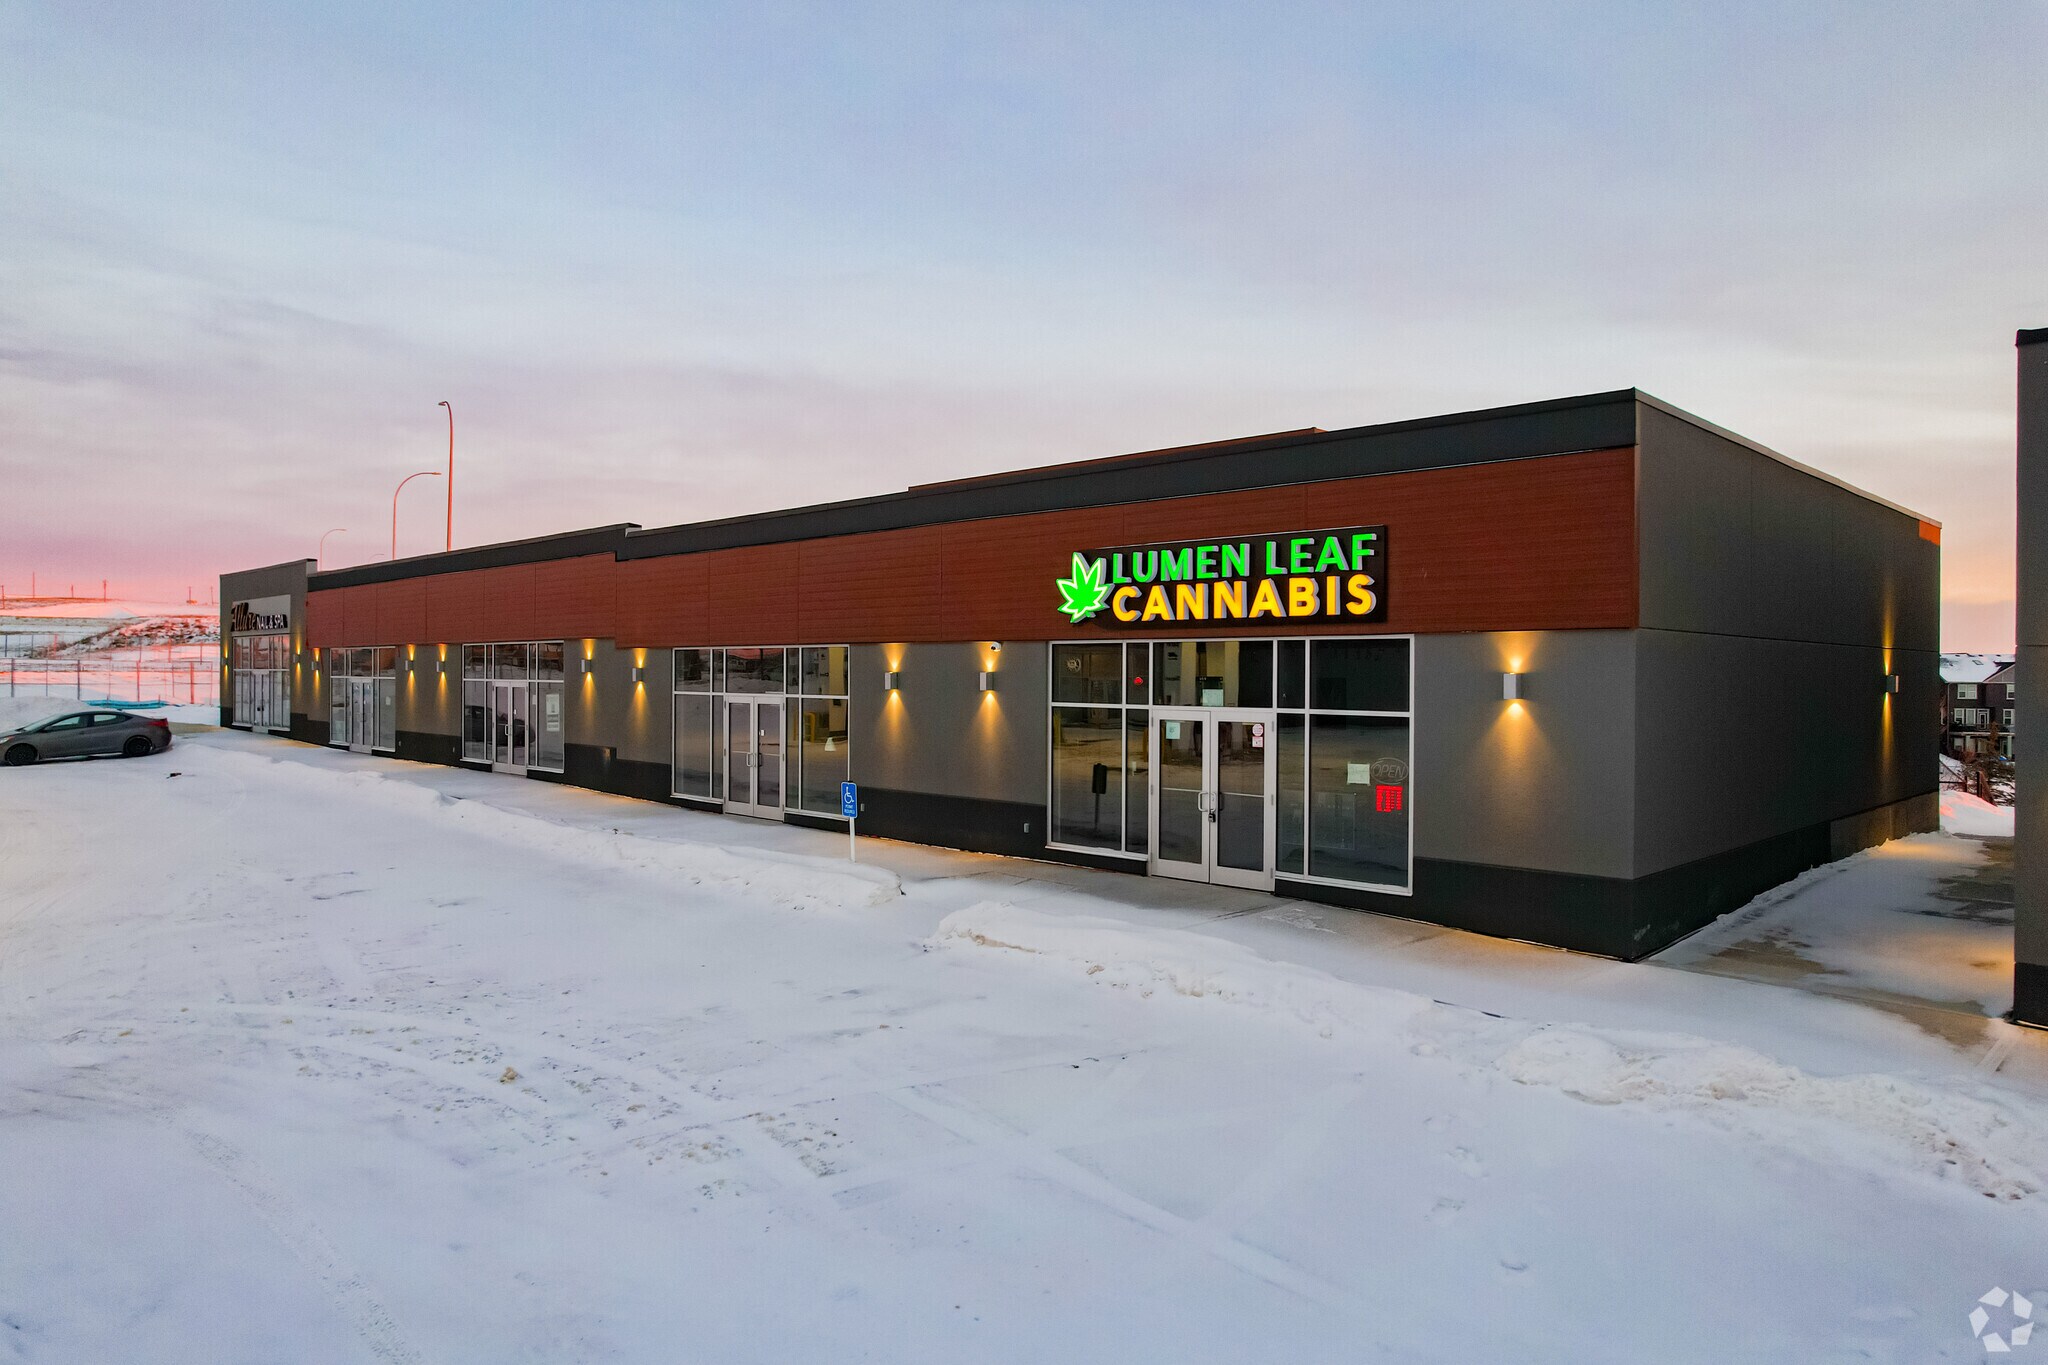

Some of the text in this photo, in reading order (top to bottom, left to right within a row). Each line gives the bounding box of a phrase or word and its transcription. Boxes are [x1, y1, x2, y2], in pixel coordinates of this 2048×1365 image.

[1113, 533, 1377, 583] LUMEN LEAF
[1113, 574, 1377, 622] CANNABIS
[274, 614, 285, 629] SPA
[1373, 764, 1405, 778] OPEN
